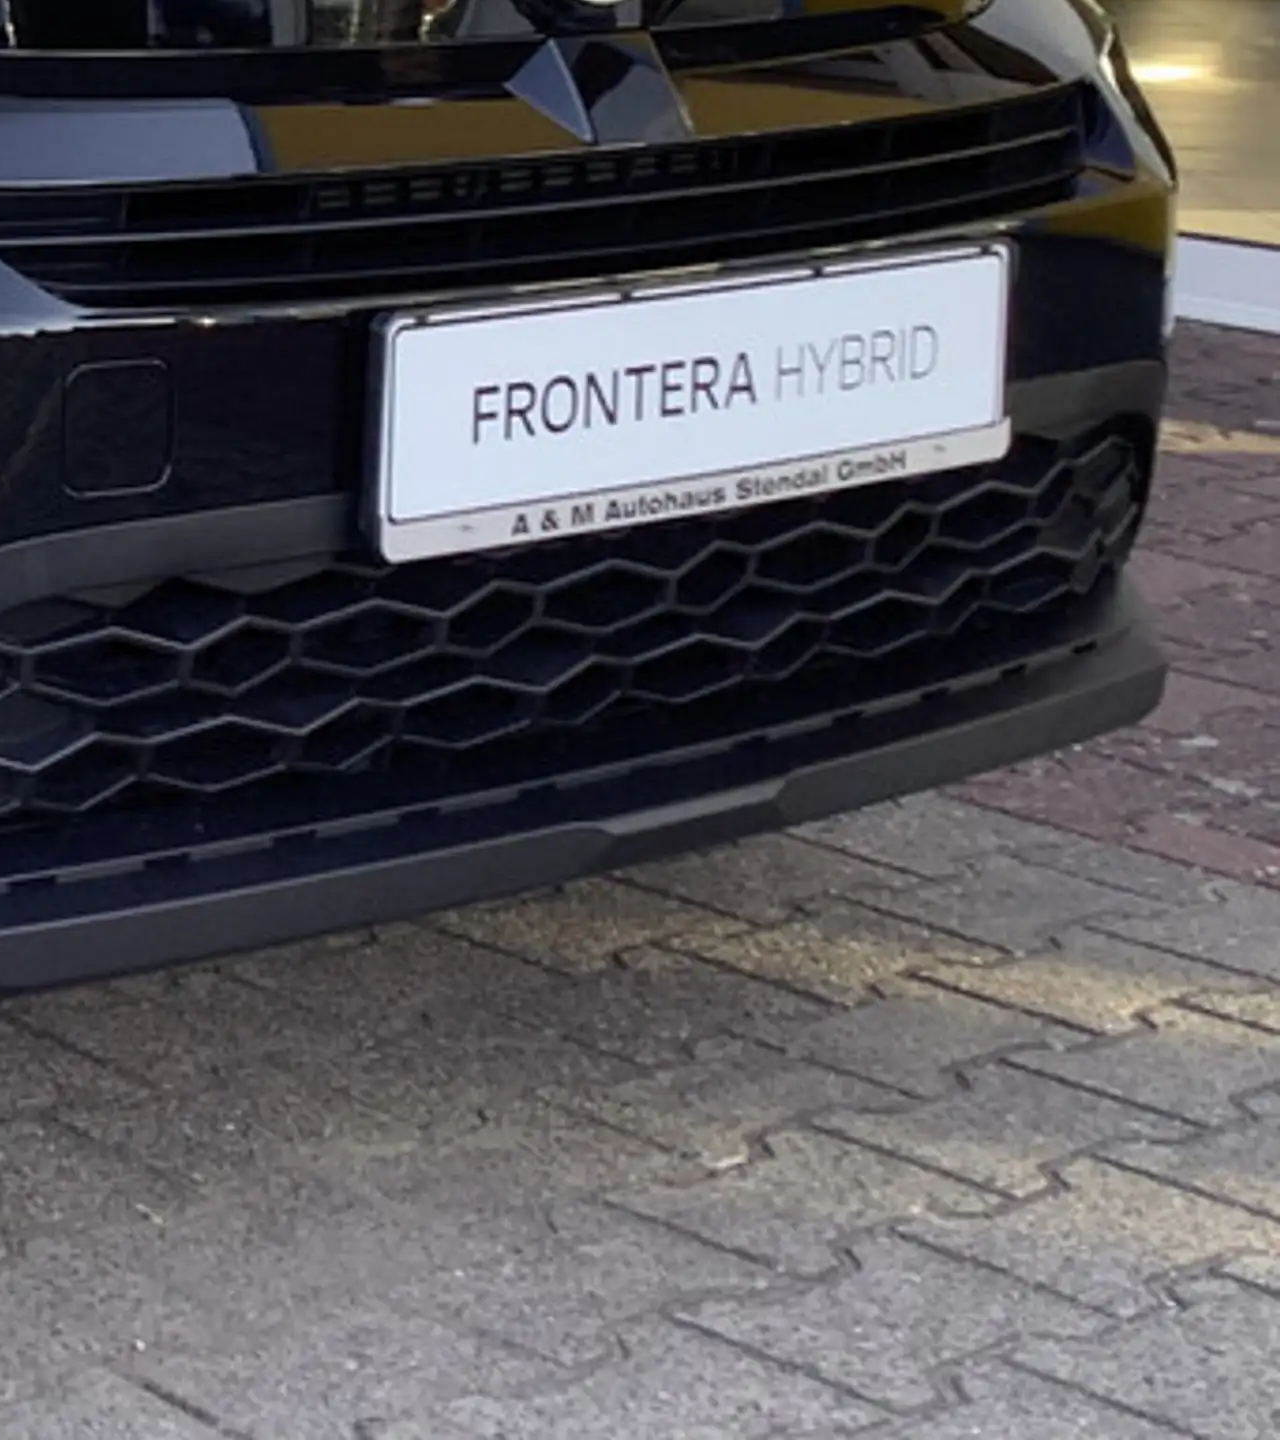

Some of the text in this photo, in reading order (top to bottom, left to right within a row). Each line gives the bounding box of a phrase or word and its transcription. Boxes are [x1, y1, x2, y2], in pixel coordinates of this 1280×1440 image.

[472, 324, 939, 445] FRONTERA HYBRID
[510, 449, 907, 537] A & M Autohaus Stendal GmbH
